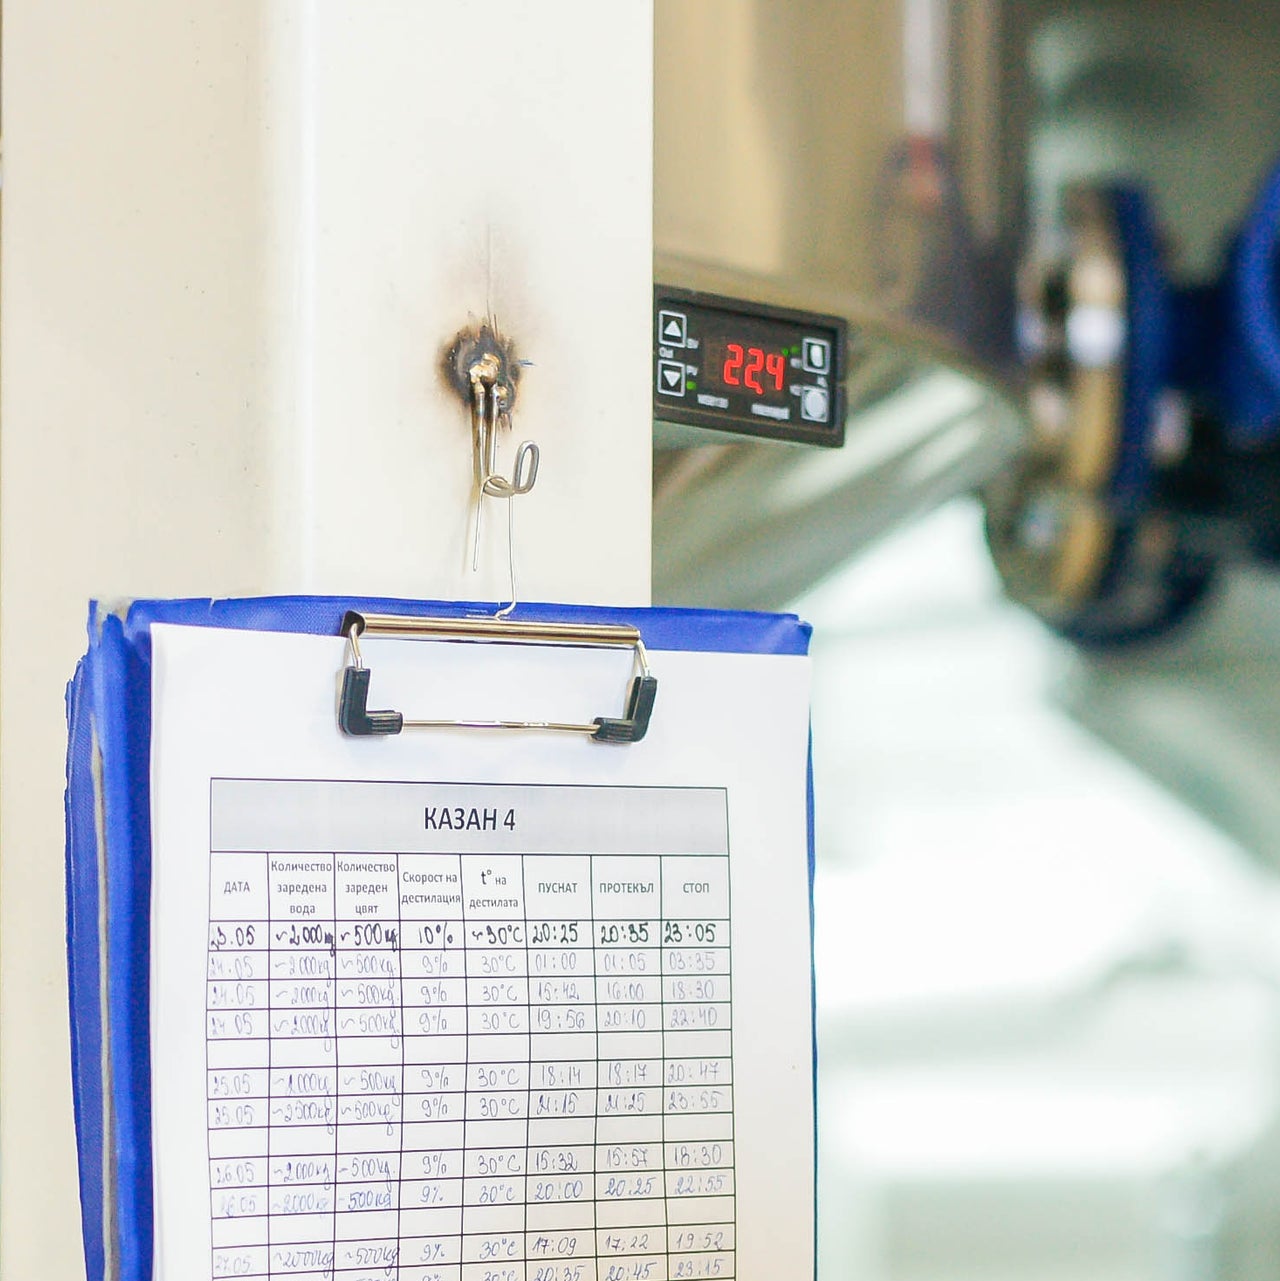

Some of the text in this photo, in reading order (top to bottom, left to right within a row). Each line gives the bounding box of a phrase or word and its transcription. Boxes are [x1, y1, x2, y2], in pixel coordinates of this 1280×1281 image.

[424, 807, 516, 831] КАЗАН 4
[271, 861, 332, 872] Количество
[337, 861, 395, 873] Количество
[402, 872, 457, 885] Скорост на
[495, 877, 507, 885] на
[224, 881, 250, 894] ДАТА
[277, 883, 327, 895] заредена
[345, 884, 388, 896] зареден
[538, 882, 578, 893] ПУСНАТ
[600, 882, 654, 893] ПРОТЕКЪЛ
[683, 882, 709, 893] СТОП
[401, 894, 460, 905] дестилация
[469, 899, 518, 909] дестилата
[290, 905, 316, 914] вода
[355, 905, 379, 914] цвят
[419, 922, 453, 948] 10%
[532, 922, 578, 944] 20:25
[601, 922, 648, 944] 20:35
[664, 922, 716, 943] 23:05
[536, 952, 576, 971] 01:00
[670, 952, 715, 970] 03:35
[537, 1007, 584, 1029] 19:56
[542, 1066, 580, 1086] 18:14
[536, 1150, 578, 1171] 15:32
[532, 1236, 577, 1255] 17:09
